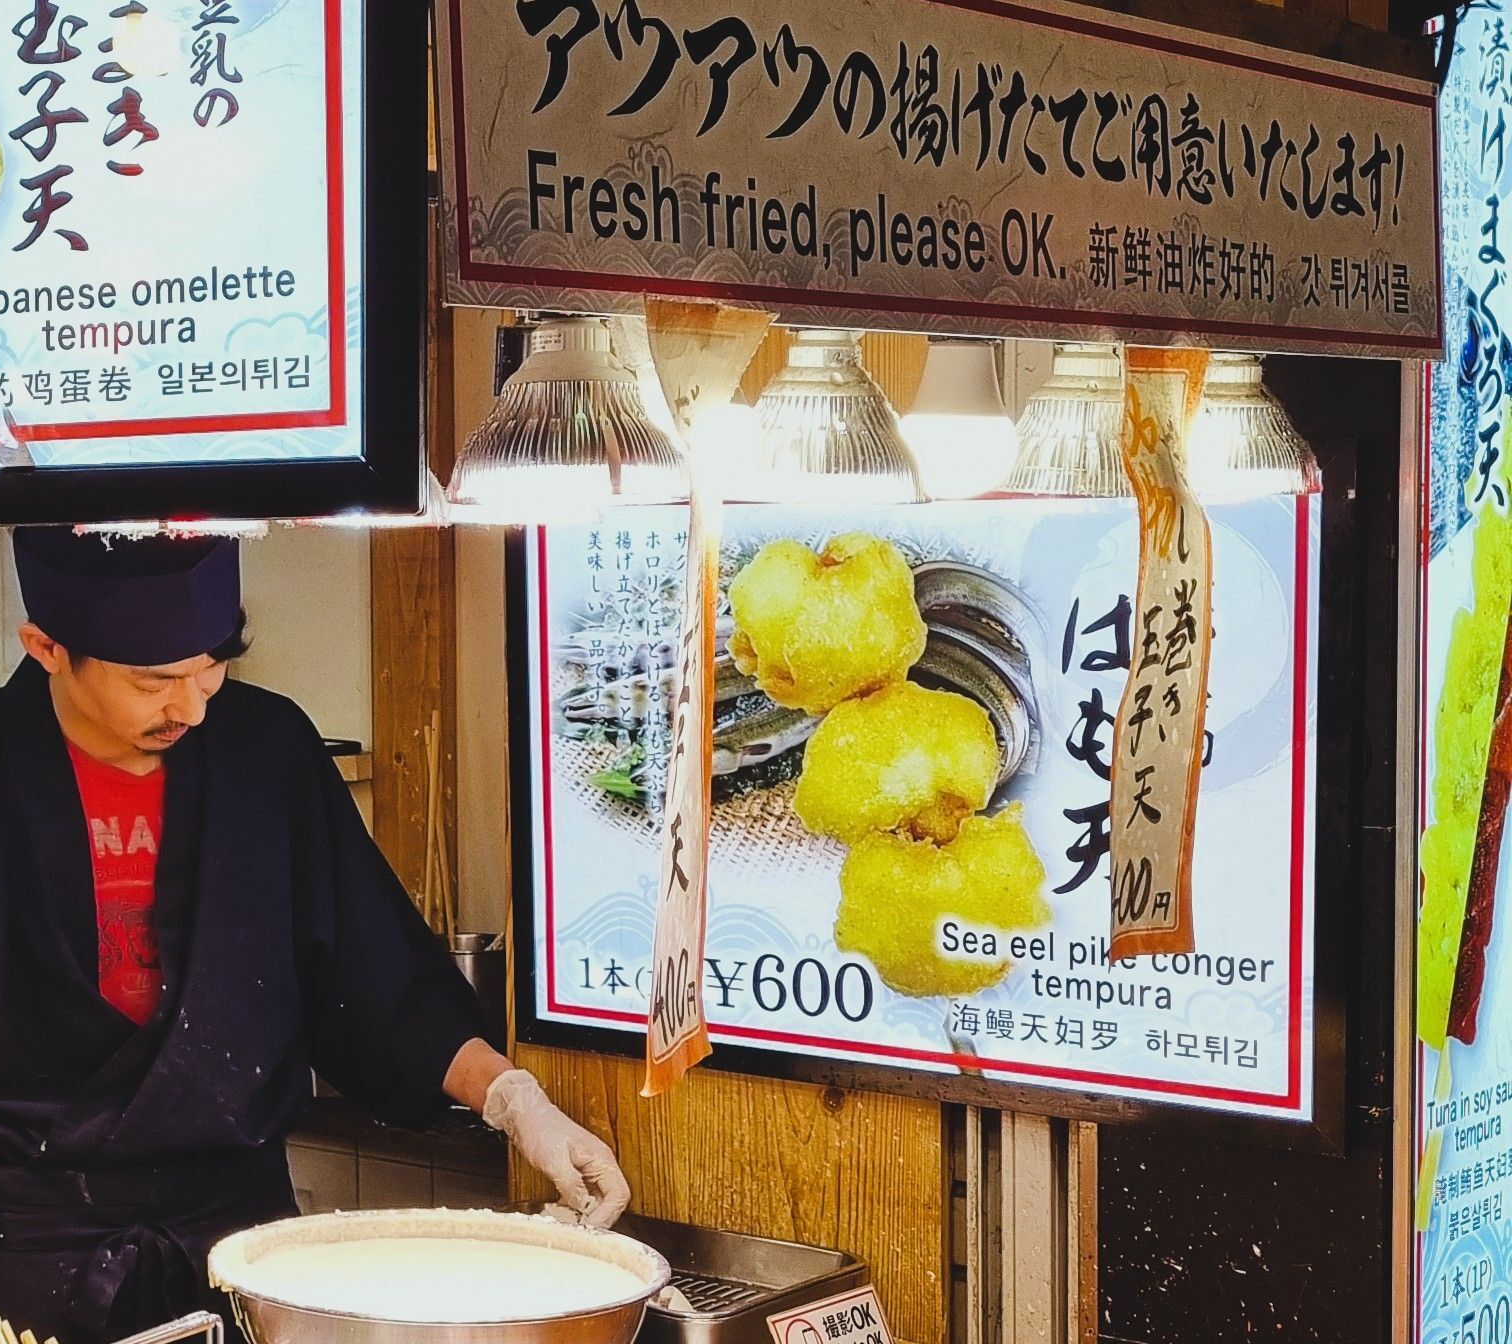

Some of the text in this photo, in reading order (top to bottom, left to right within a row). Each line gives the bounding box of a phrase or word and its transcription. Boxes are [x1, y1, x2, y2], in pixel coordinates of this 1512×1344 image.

[527, 150, 1068, 281] Fresh fried, please OK.
[1088, 223, 1276, 305] 新鲜油炸好的
[1300, 253, 1410, 314] 갓 튀겨서콜
[1474, 14, 1511, 507] 漬けまぐろ天
[130, 266, 296, 308] omelette
[42, 315, 197, 355] tempura
[156, 355, 311, 398] 일본의튀김
[587, 530, 607, 713] 美味しい一品です。
[645, 530, 666, 827] ホロリとほどけるはも天ぷら。
[942, 922, 997, 956] Sea
[1010, 932, 1054, 961] eel
[1152, 951, 1274, 985] conger
[705, 951, 875, 1023] ¥600
[1031, 968, 1172, 1010] tempura
[951, 1003, 1119, 1051] 海鳗天妇罗
[1145, 1029, 1259, 1069] 하모튀김
[1427, 1098, 1458, 1130] Tuna
[1460, 1090, 1471, 1120] in
[1473, 1086, 1494, 1116] soy
[1454, 1114, 1502, 1152] tempura
[1440, 1256, 1494, 1309] 1本(1P)
[822, 1301, 878, 1341] 撮影OK
